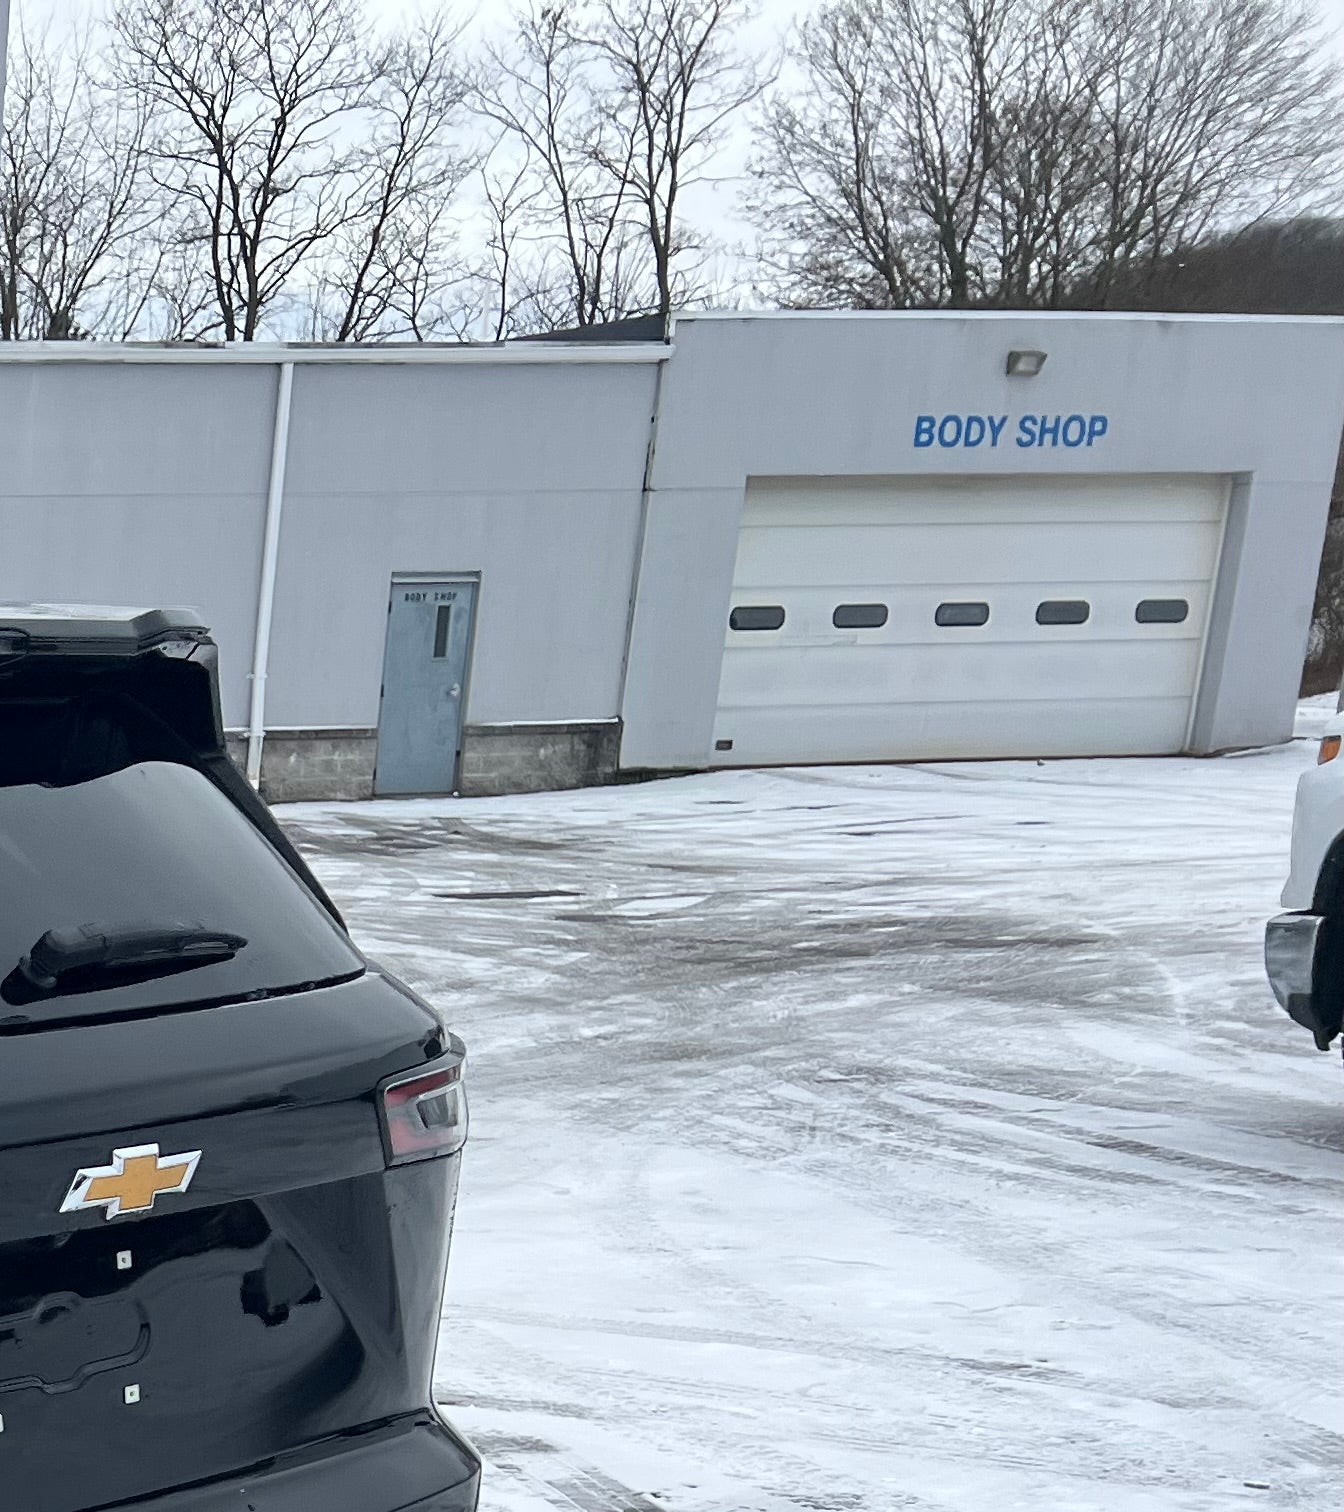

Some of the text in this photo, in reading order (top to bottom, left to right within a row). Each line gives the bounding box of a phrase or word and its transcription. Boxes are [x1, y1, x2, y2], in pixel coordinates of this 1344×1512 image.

[914, 415, 1108, 447] BODY SHOP
[404, 592, 458, 602] BODY SHOP
